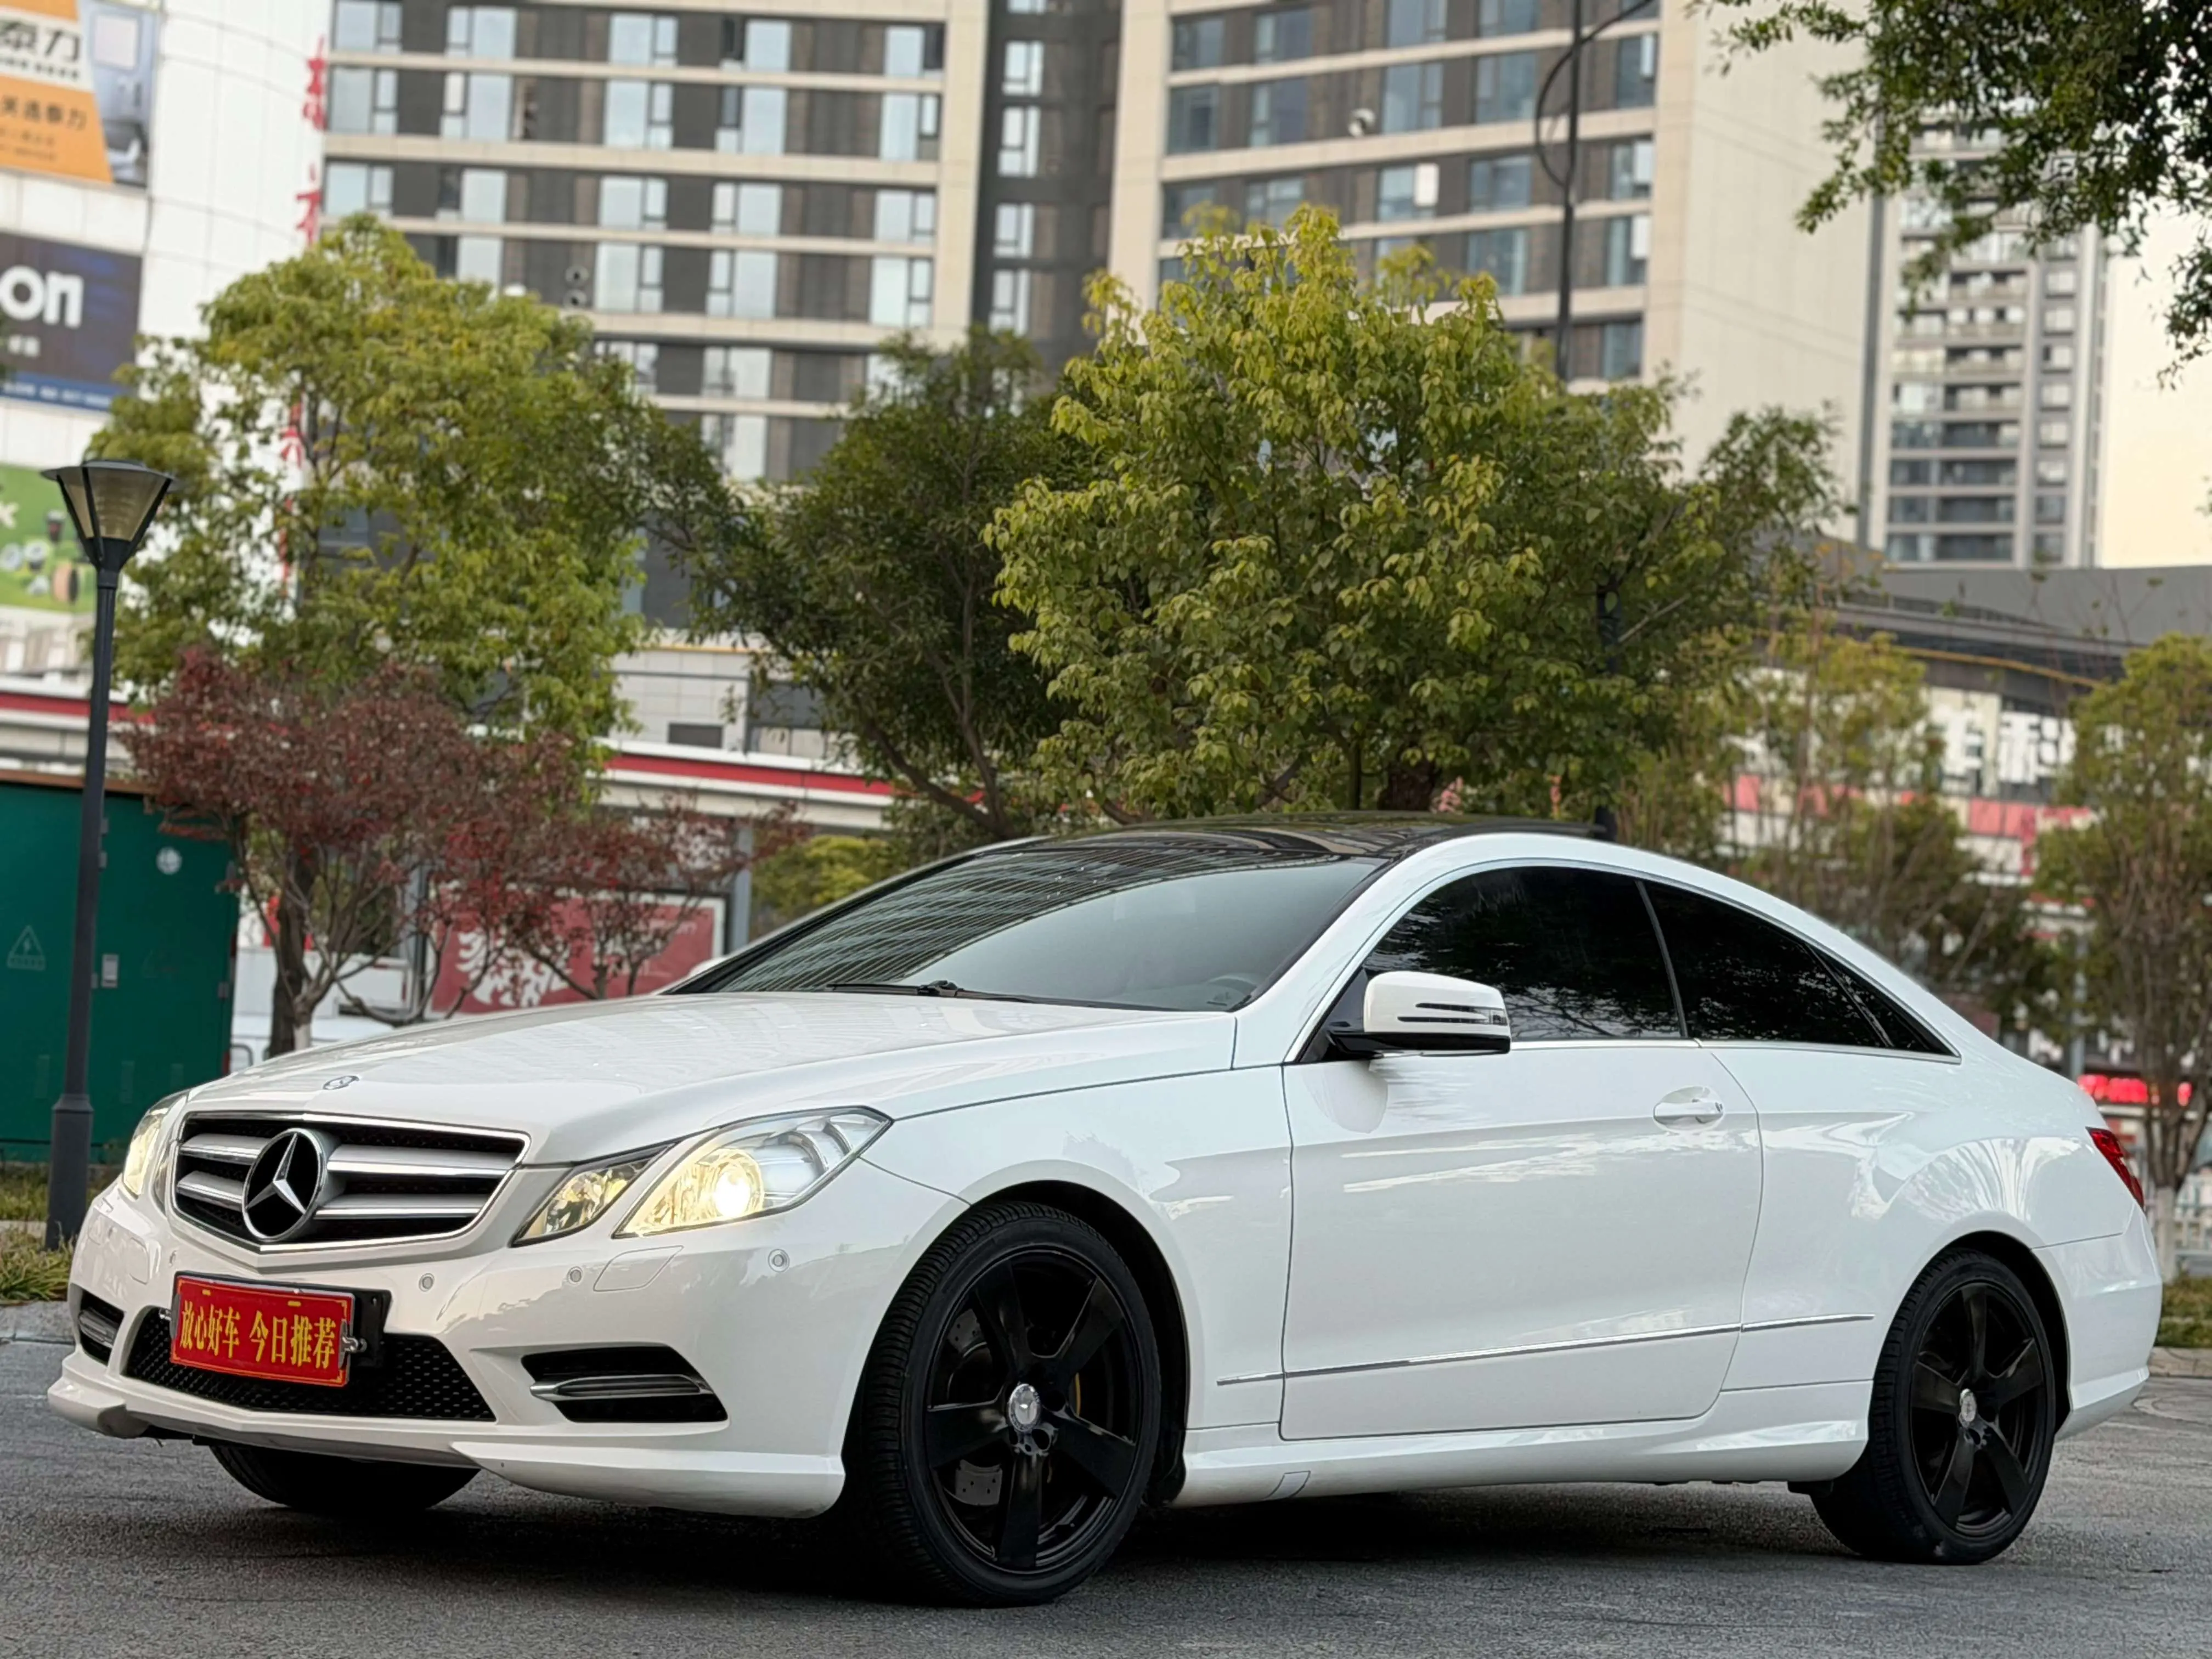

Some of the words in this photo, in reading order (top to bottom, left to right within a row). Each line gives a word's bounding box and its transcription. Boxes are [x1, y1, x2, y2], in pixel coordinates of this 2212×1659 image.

[180, 1300, 240, 1358] 放心好车
[249, 1310, 336, 1369] 今日推荐
